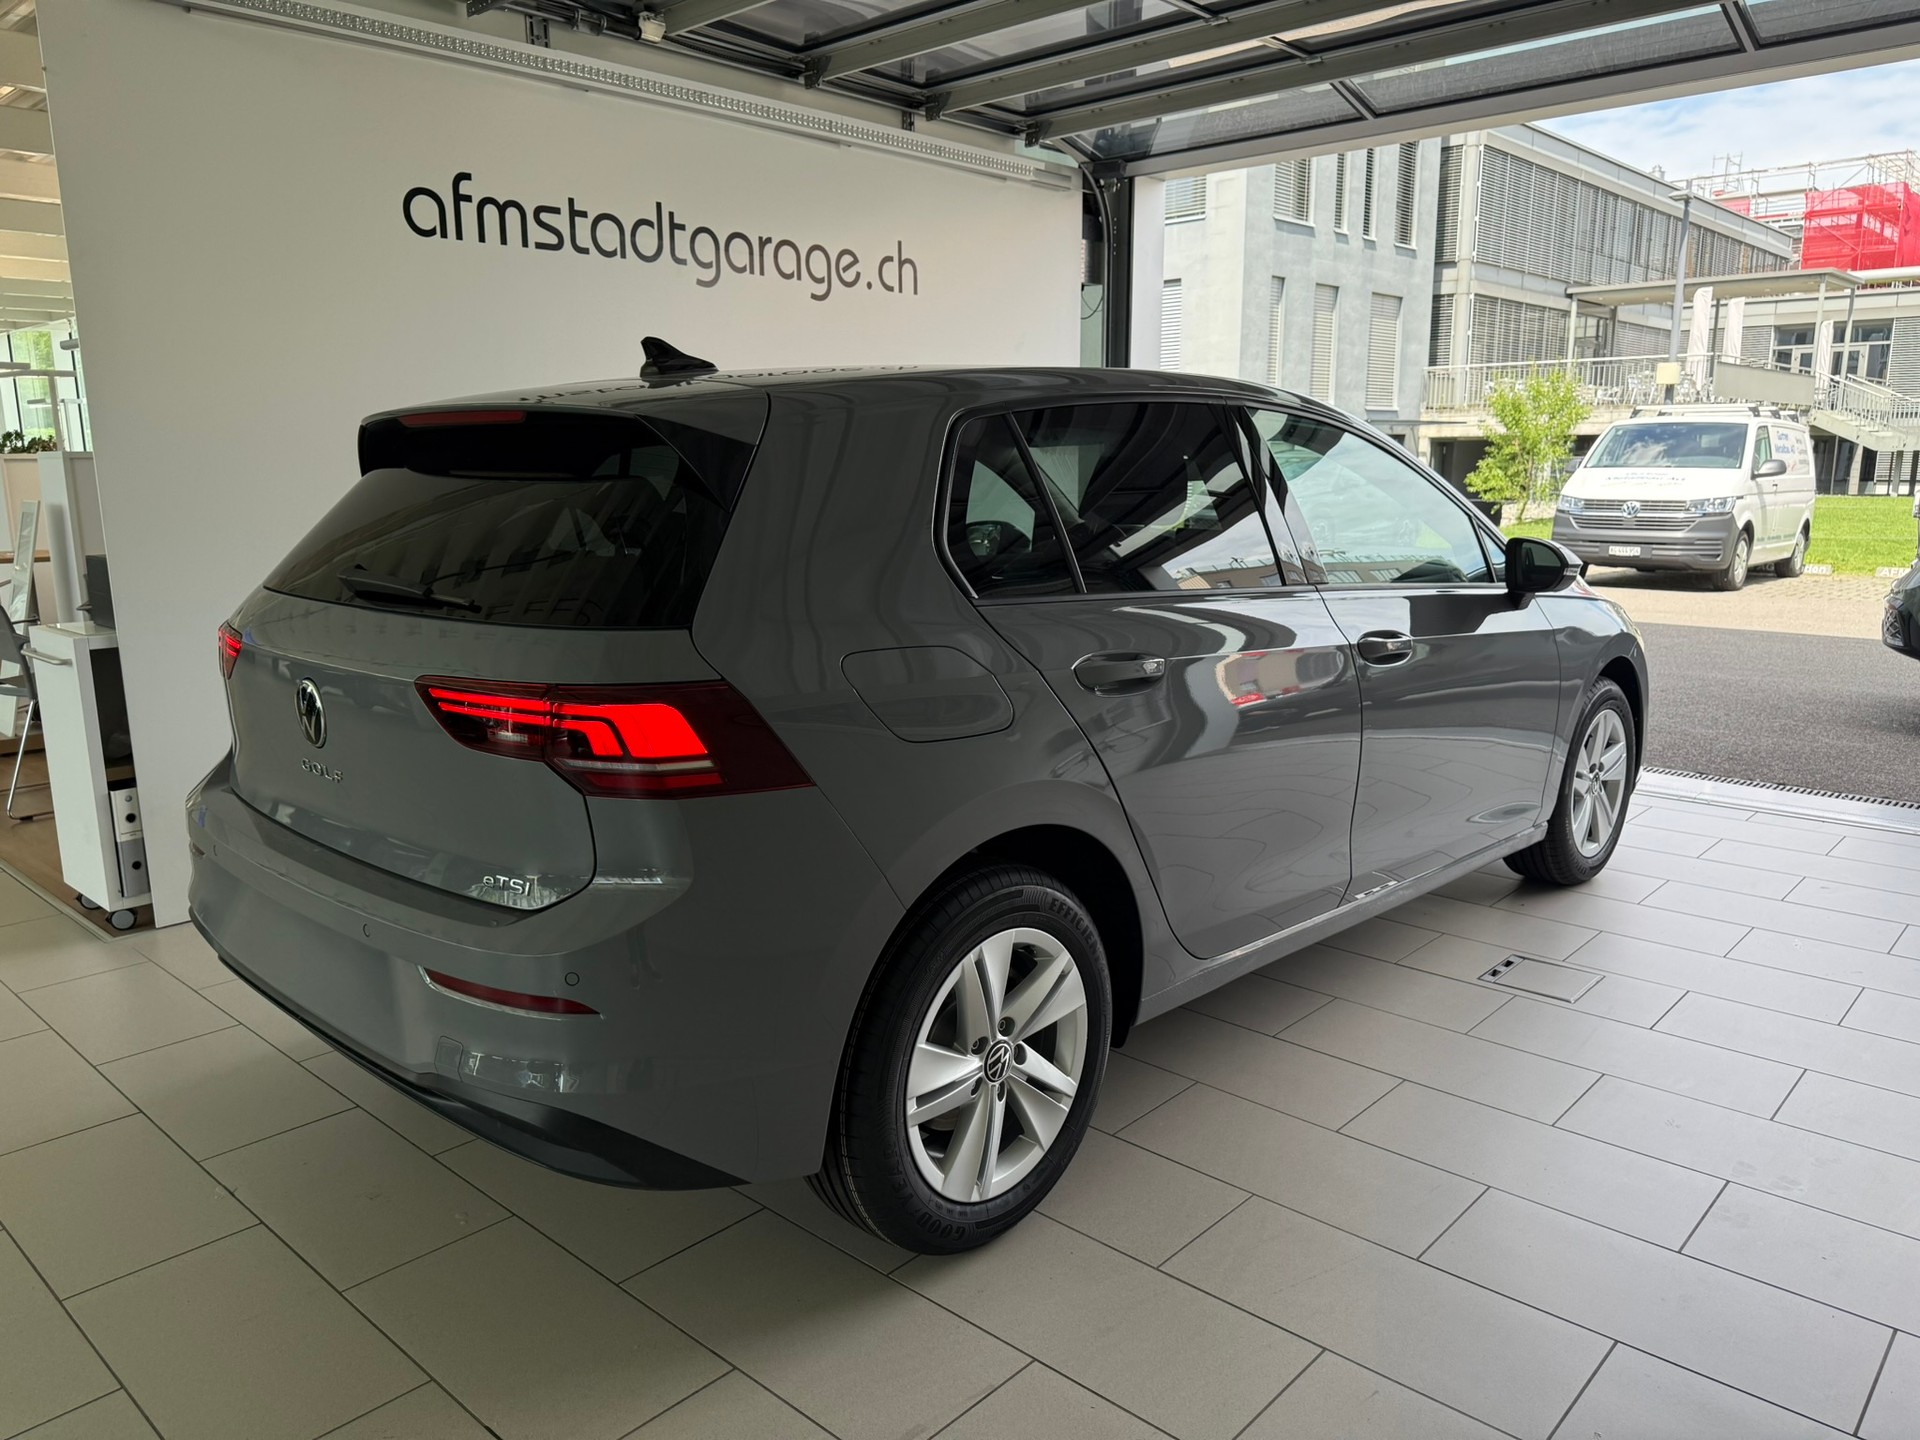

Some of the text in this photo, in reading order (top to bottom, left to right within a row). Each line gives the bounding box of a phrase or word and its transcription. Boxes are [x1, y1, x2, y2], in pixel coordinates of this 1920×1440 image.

[402, 171, 919, 302] afmstadtgarage.ch
[302, 758, 343, 783] GOLF
[483, 875, 530, 896] eTSI
